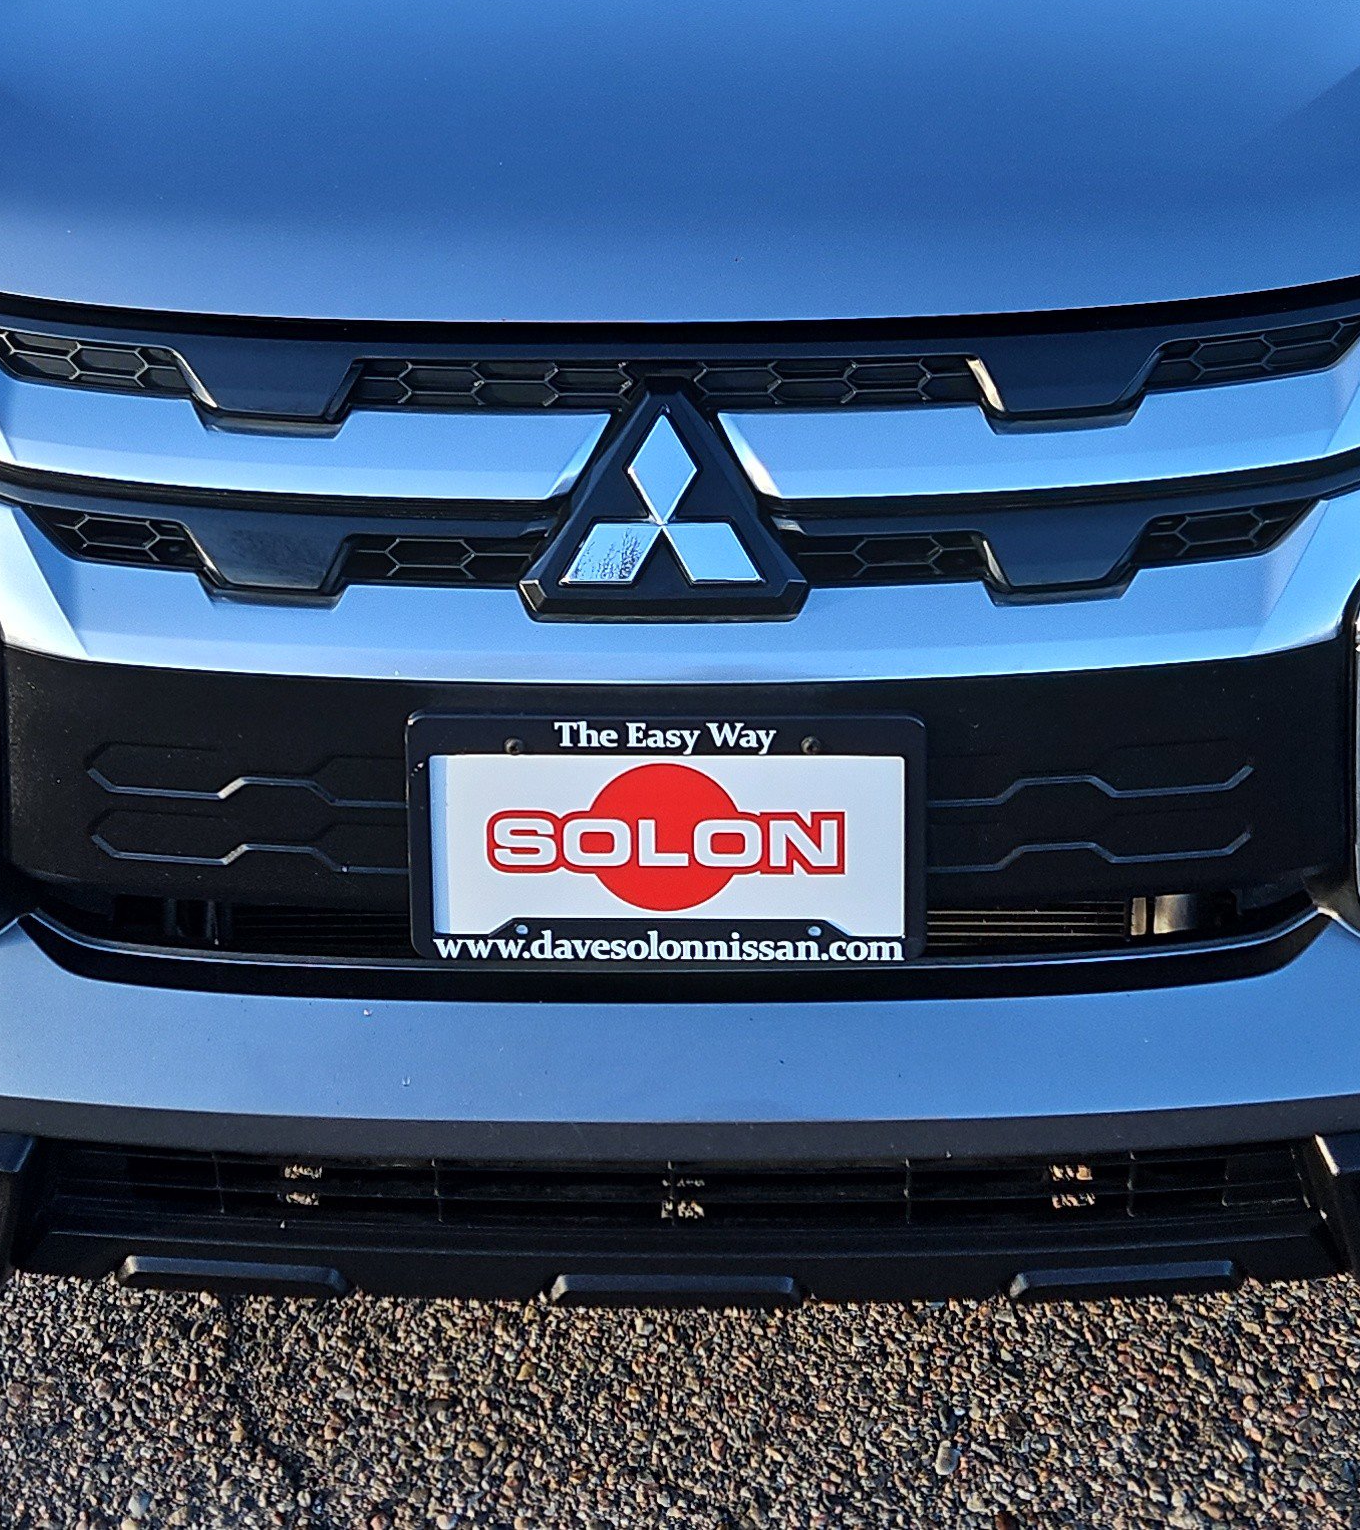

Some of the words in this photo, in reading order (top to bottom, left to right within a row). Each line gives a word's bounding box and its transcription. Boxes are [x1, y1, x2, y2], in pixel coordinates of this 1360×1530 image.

[554, 721, 619, 748] The
[626, 722, 701, 755] Easy
[706, 722, 777, 755] Way
[488, 811, 845, 874] SOLON
[433, 929, 905, 962] www.davesolonnissan.com
